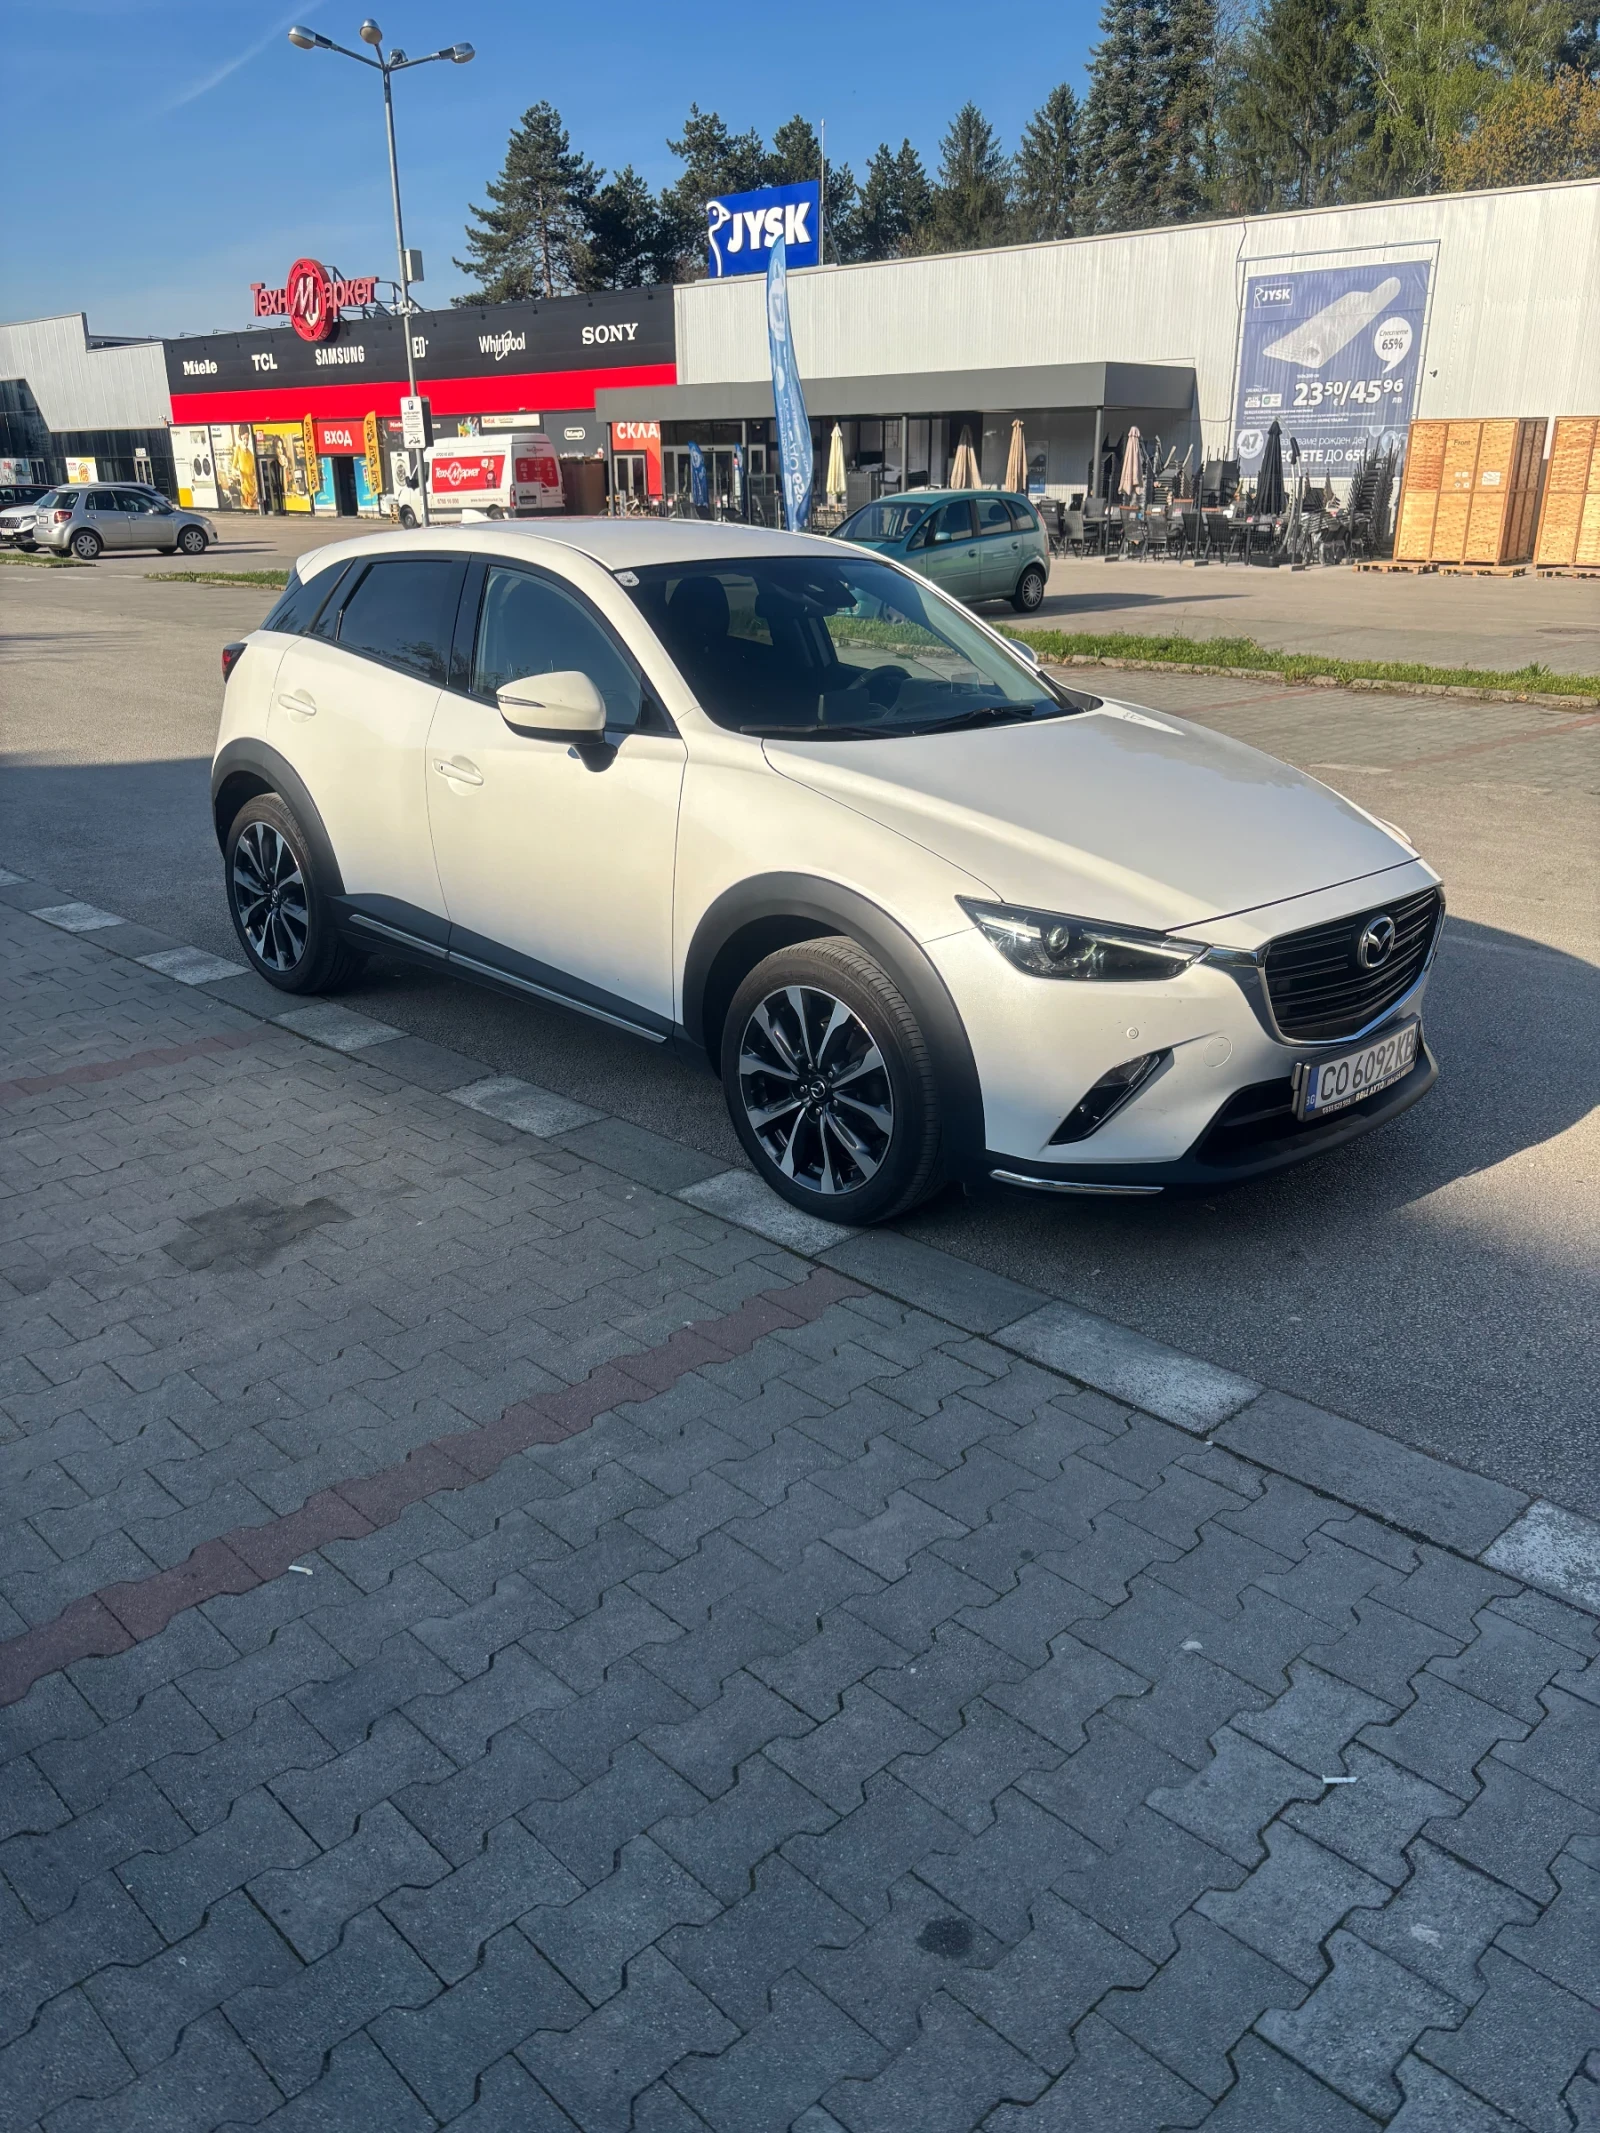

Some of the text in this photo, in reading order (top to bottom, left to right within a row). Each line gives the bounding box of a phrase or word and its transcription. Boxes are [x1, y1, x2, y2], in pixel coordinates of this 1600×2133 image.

[727, 202, 811, 252] JYSK
[1262, 289, 1291, 301] JYSK
[582, 323, 638, 344] SONY
[479, 330, 525, 361] Whirlpool
[1382, 338, 1403, 350] 65%
[251, 353, 278, 371] TCL
[315, 345, 365, 366] SAMSUNG
[183, 359, 218, 376] Miele
[324, 430, 352, 447] ВХОД
[1241, 433, 1259, 450] 47
[1319, 436, 1350, 448] рожден
[1325, 449, 1343, 464] ДО
[1321, 1062, 1349, 1100] CO
[1352, 1040, 1396, 1088] 6092
